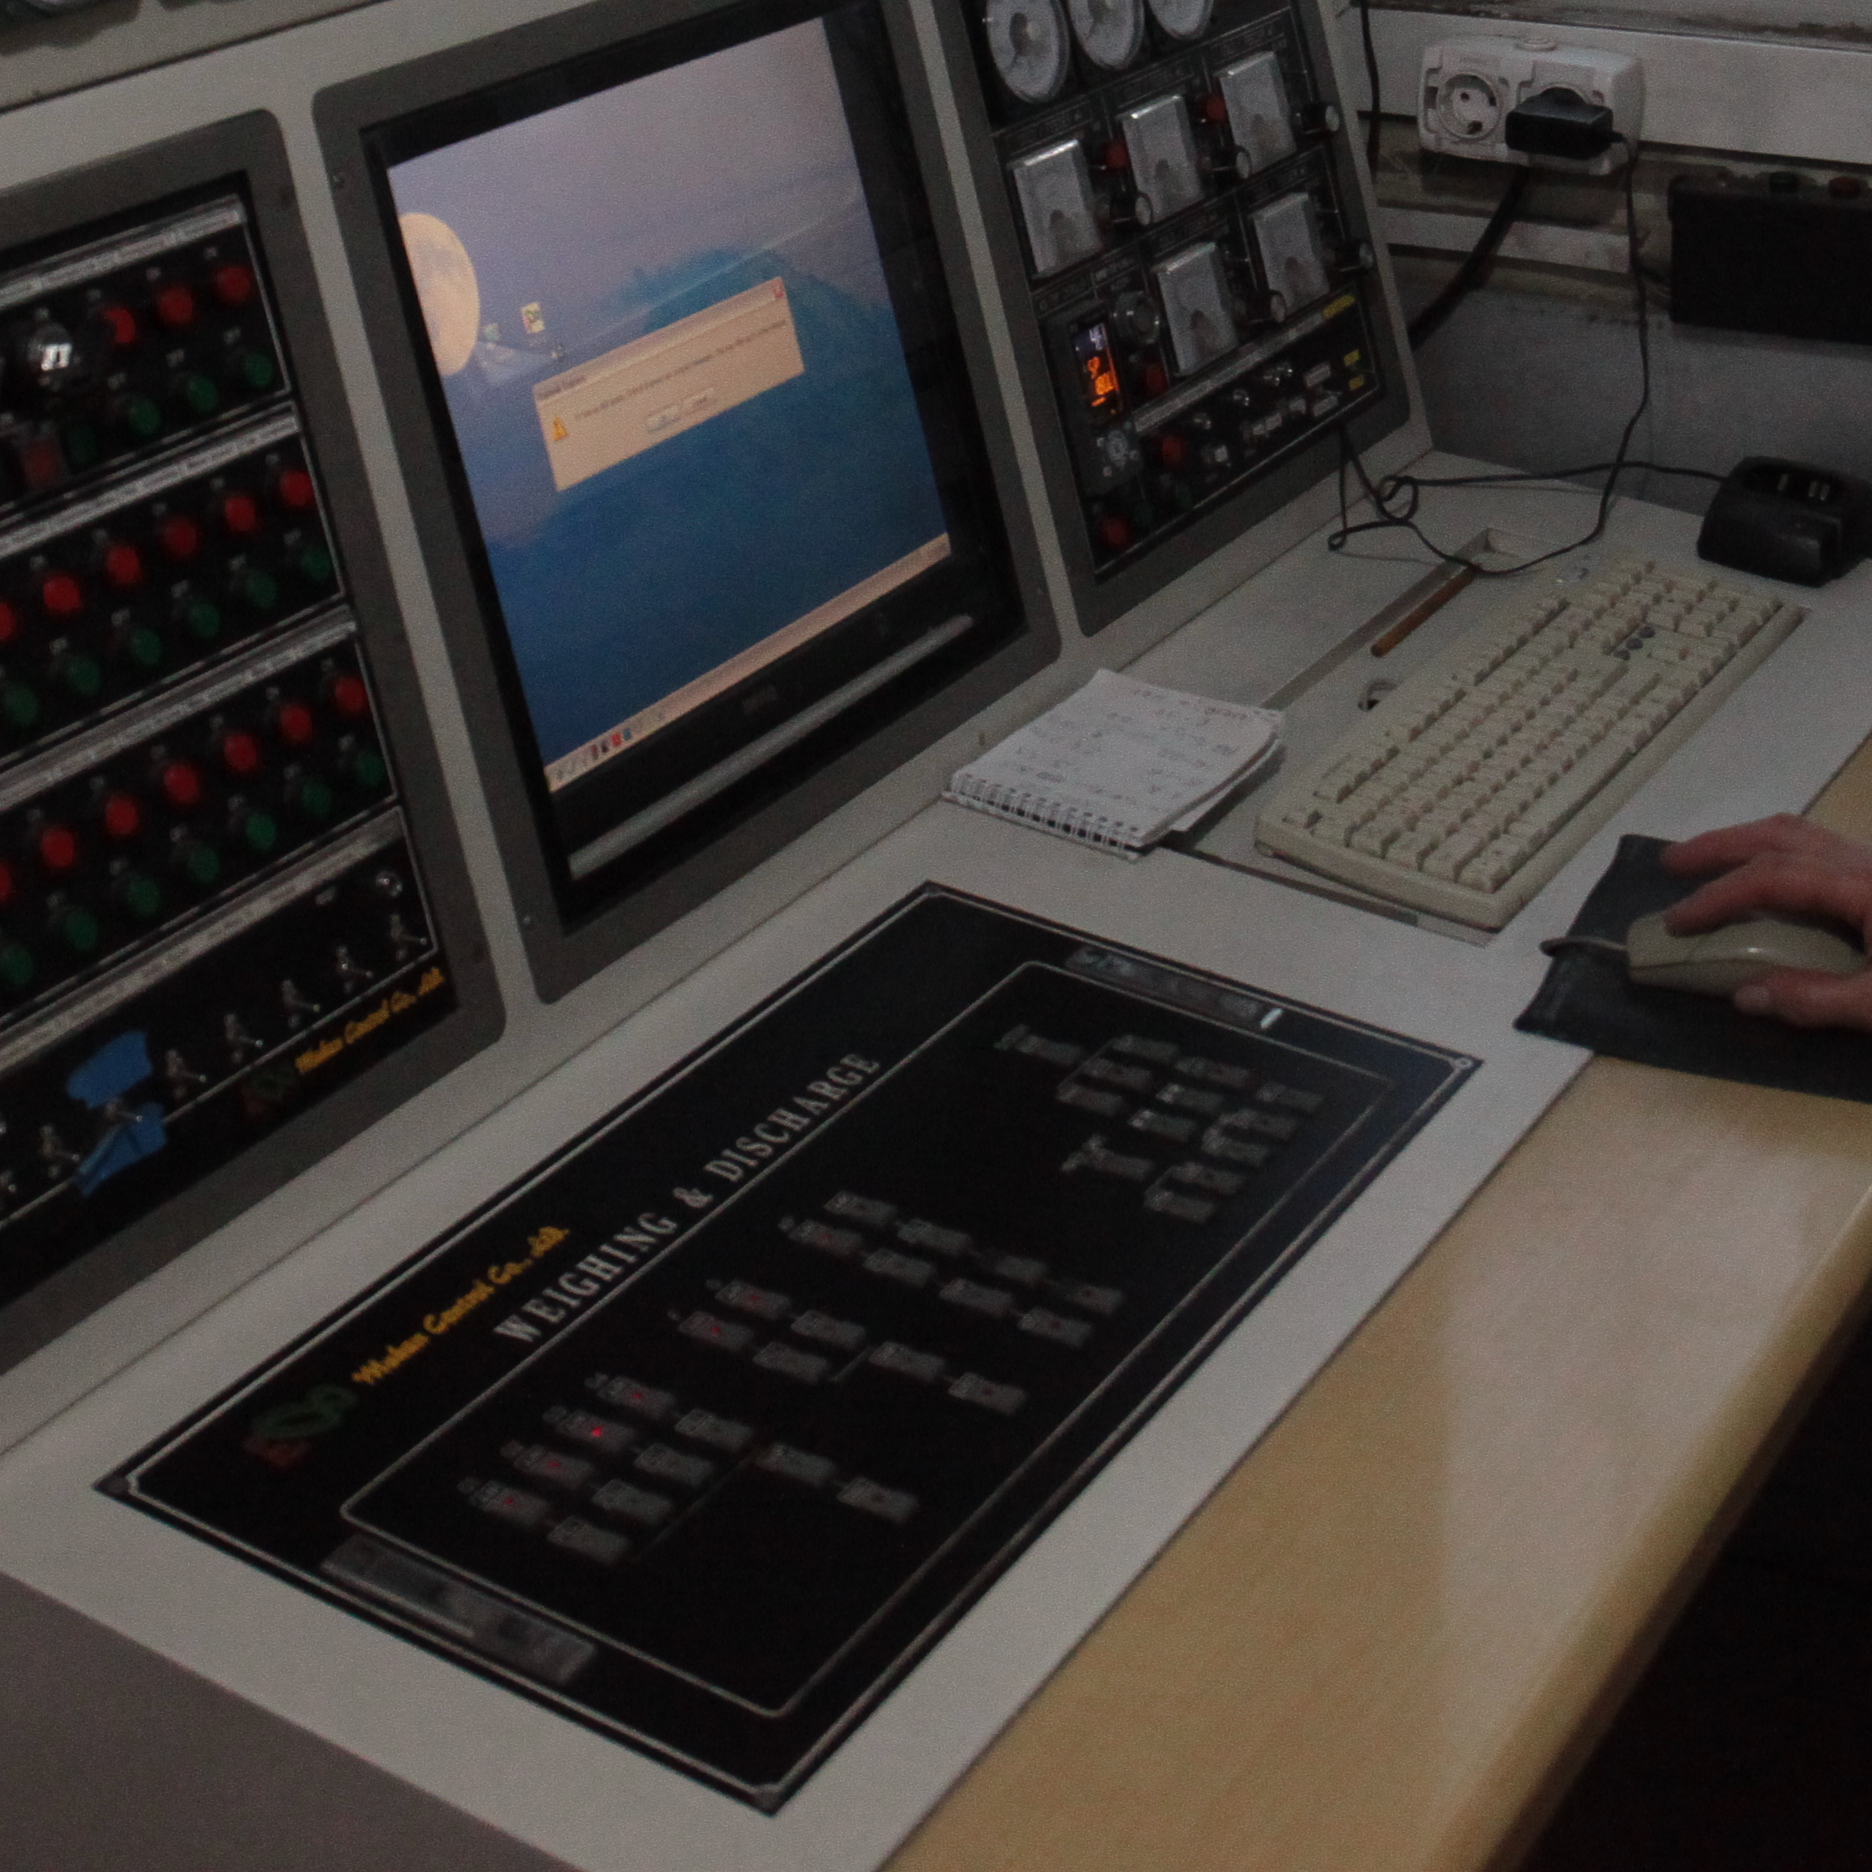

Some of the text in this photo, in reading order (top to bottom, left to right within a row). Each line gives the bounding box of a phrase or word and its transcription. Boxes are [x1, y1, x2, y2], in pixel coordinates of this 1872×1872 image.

[493, 1053, 880, 1343] WEIGHING & DISCHARGE
